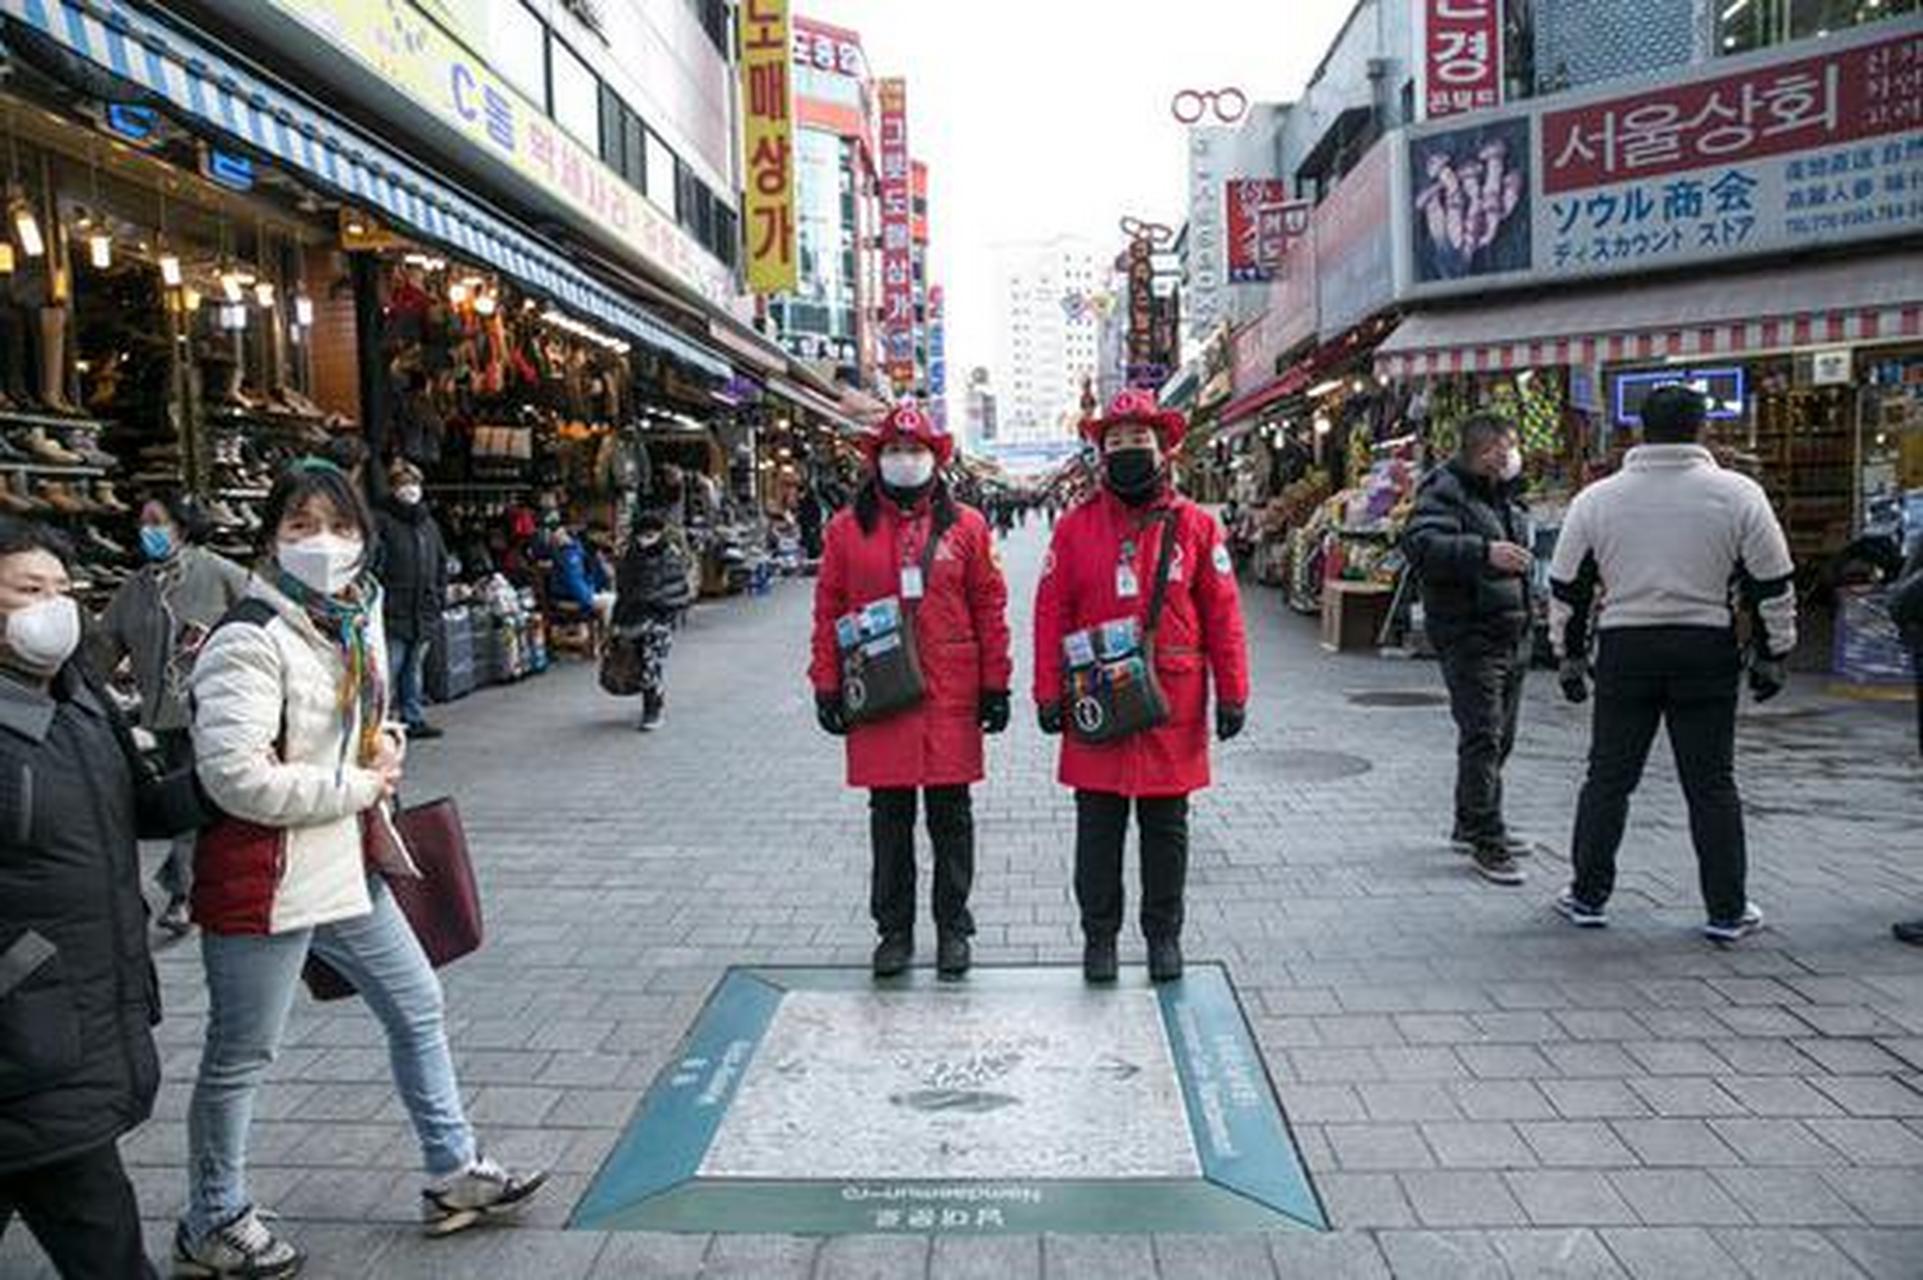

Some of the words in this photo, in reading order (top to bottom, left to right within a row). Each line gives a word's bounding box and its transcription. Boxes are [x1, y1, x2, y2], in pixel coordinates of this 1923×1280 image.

[1552, 64, 1840, 172] 서울상회
[1700, 216, 1756, 247] ストア
